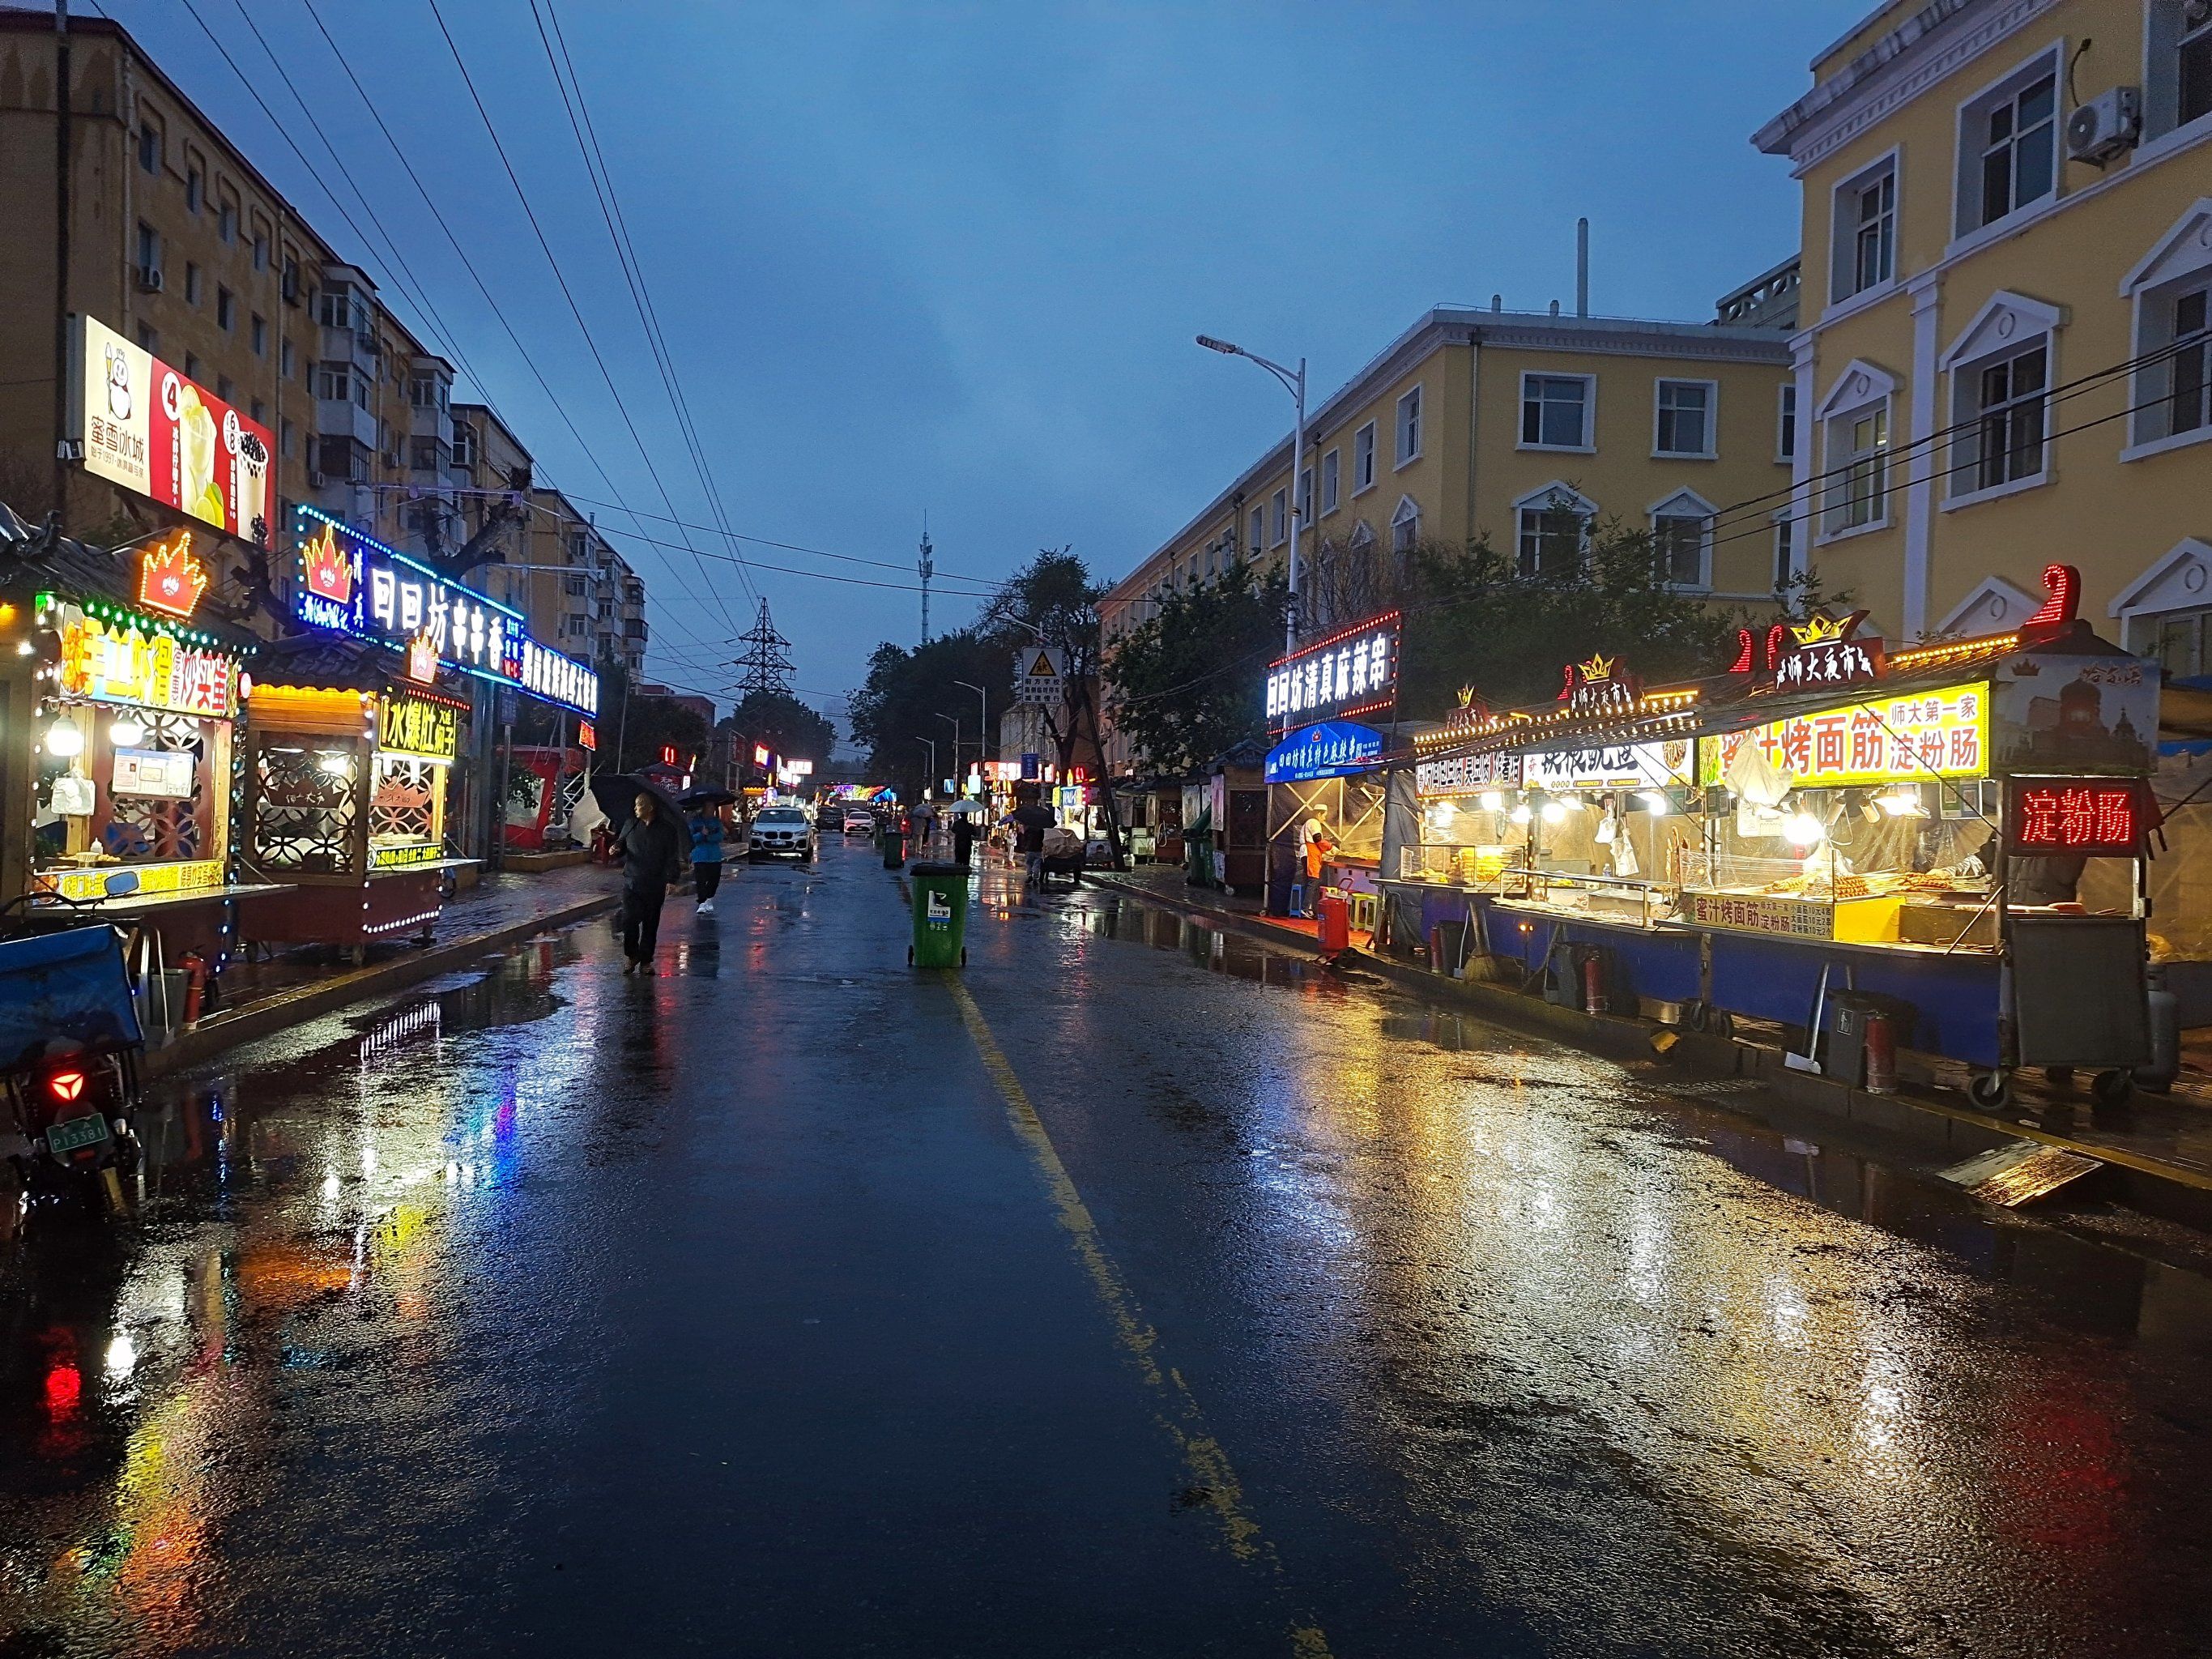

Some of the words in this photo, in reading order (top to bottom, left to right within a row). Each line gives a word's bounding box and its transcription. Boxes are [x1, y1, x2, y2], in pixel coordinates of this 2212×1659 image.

[91, 415, 144, 465] 蜜雪冰城
[230, 414, 236, 431] 6
[230, 433, 236, 450] 8
[373, 568, 504, 671] 回回坊串串香
[1267, 633, 1386, 719] 回回坊清真麻辣串
[387, 697, 436, 752] 水爆肚
[1891, 695, 1976, 726] 师大第一家
[1890, 727, 1977, 771] 淀粉肠
[2022, 788, 2130, 844] 淀粉肠
[1696, 896, 1759, 928] 蜜汁烤面筋
[1760, 914, 1790, 933] 淀粉肠
